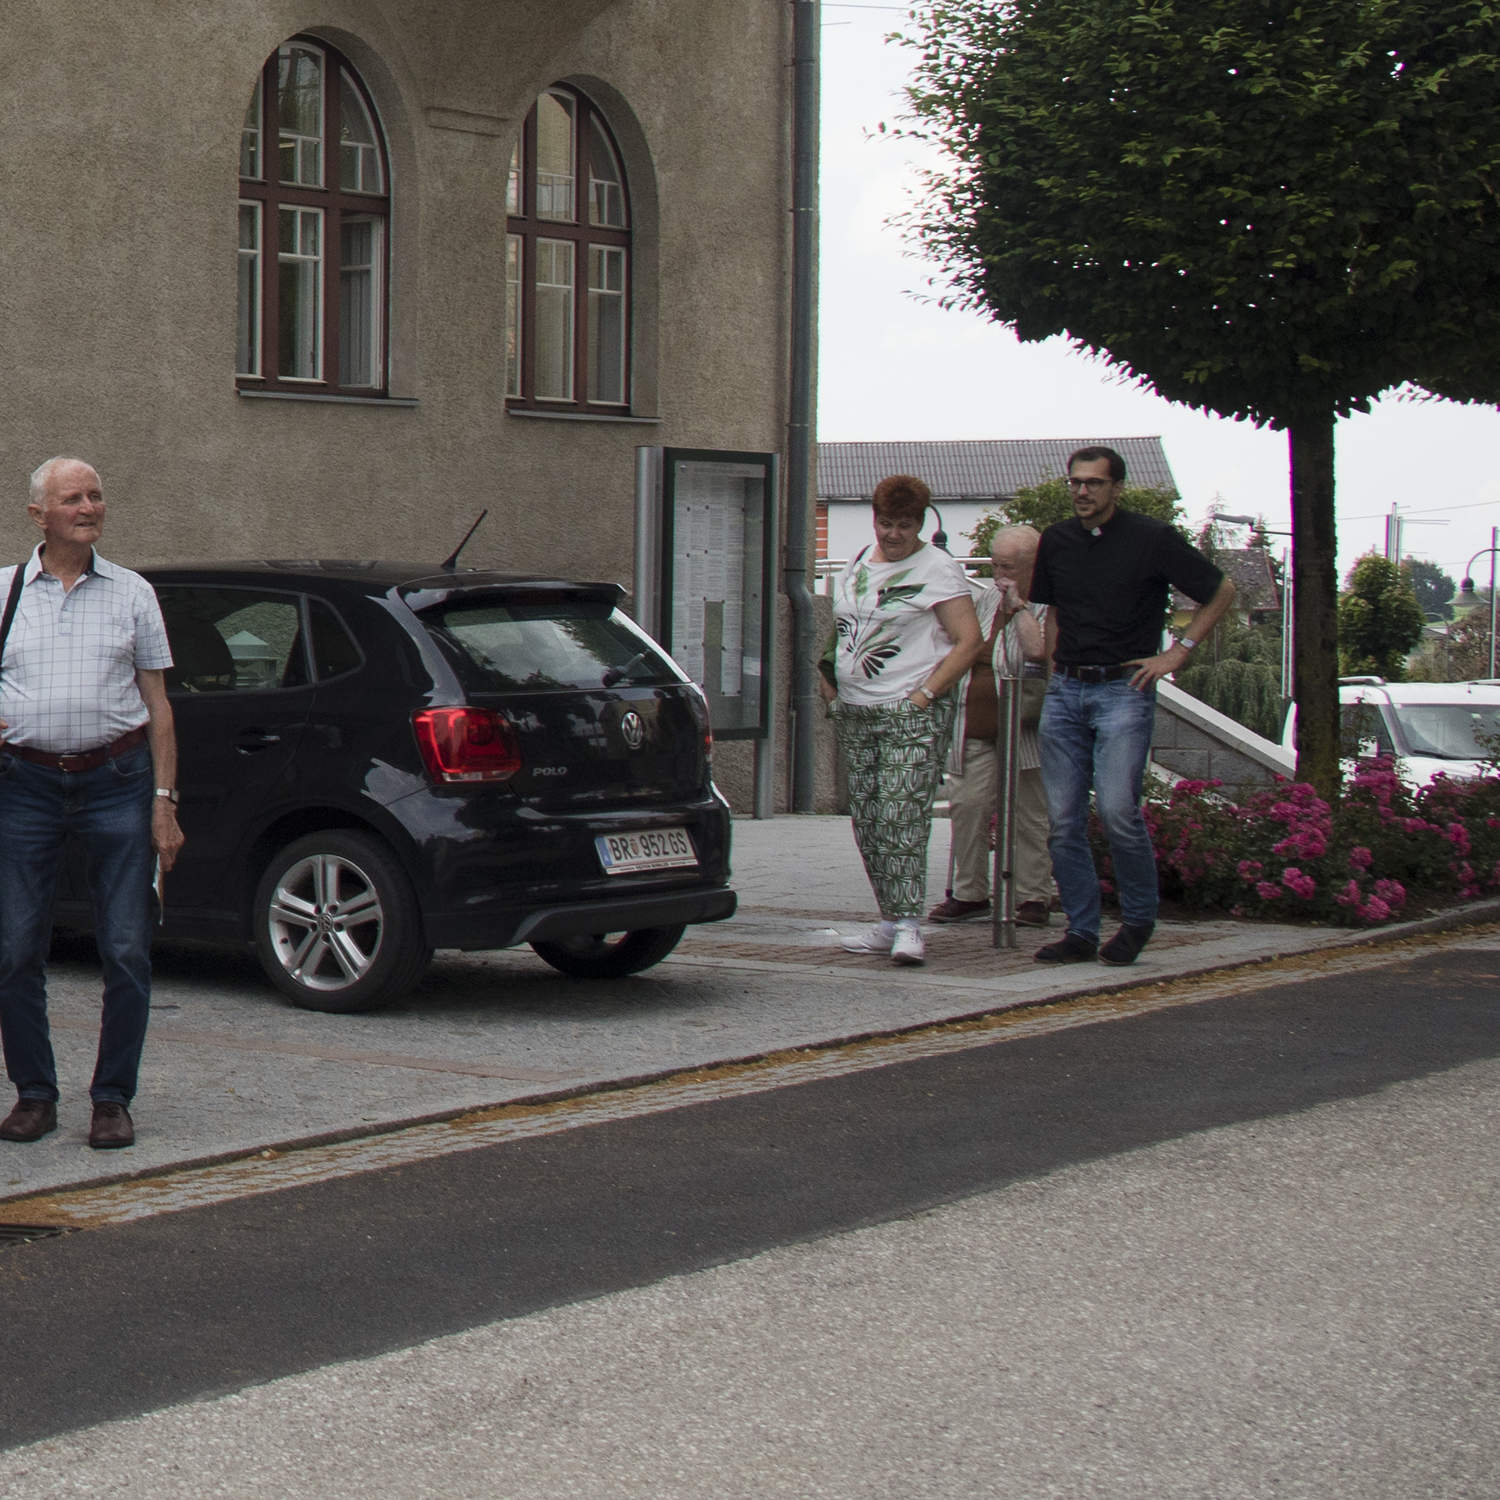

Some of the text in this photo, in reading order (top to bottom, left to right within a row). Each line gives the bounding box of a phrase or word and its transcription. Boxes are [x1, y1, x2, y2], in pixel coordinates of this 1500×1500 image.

[532, 766, 568, 777] POLO
[608, 837, 633, 861] BR
[639, 833, 669, 858] 952
[668, 831, 688, 855] GS
